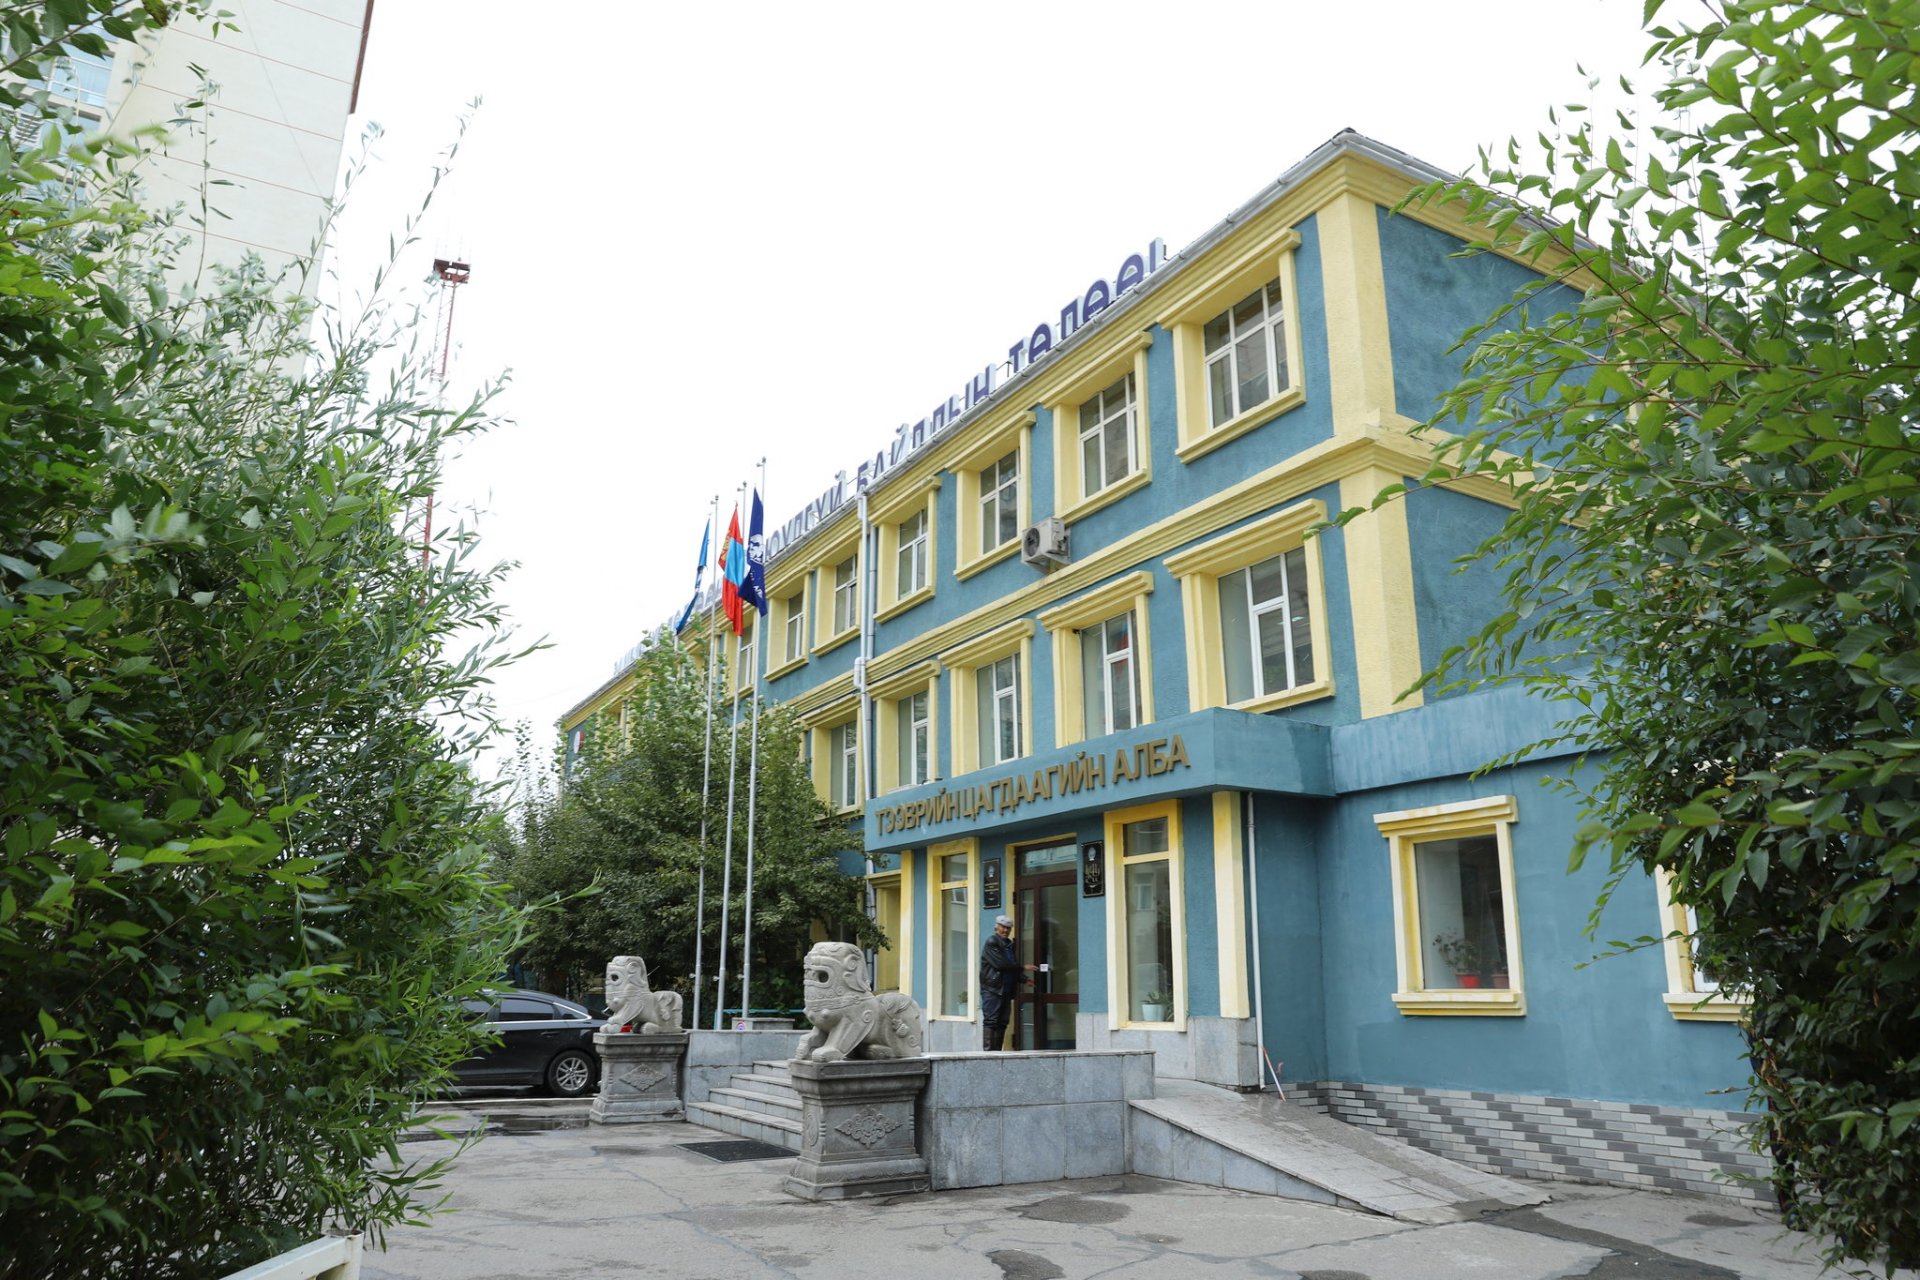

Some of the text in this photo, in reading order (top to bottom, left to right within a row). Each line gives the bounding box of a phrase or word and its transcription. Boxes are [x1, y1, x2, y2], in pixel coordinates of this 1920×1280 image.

[875, 735, 1191, 836] ТЭЭВРИЙН ЦАГДААГИЙН АЛБА
